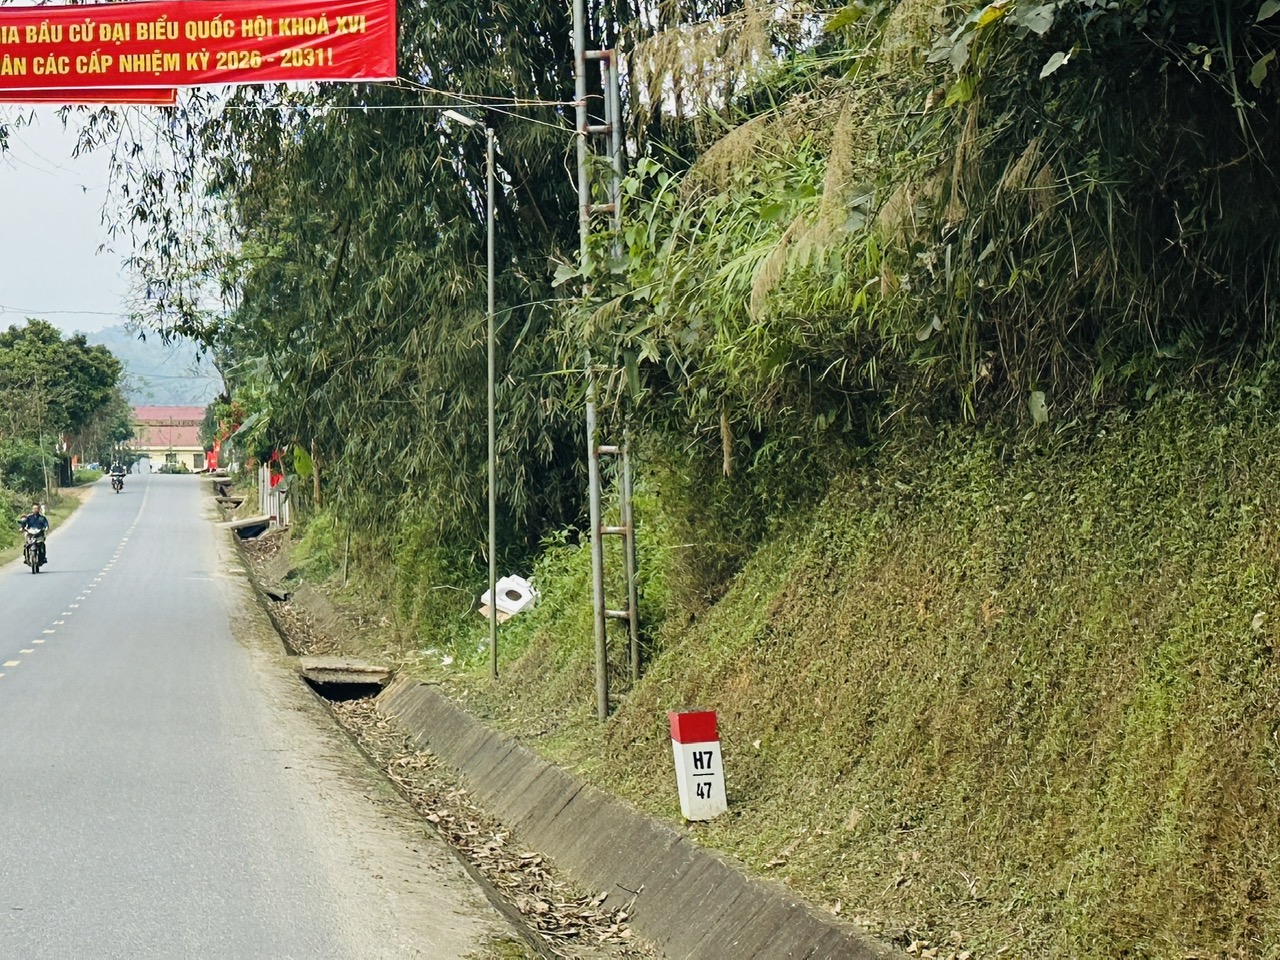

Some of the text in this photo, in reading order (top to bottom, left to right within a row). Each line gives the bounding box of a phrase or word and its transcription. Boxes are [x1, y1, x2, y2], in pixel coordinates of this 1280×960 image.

[25, 19, 62, 44] BẦU
[69, 18, 96, 42] CỬ
[99, 23, 130, 45] ĐẠI
[136, 14, 179, 40] BIỂU
[185, 13, 235, 41] QUỐC
[242, 15, 272, 41] HỘI
[336, 15, 366, 34] XVI
[33, 52, 70, 75] CÁC
[76, 48, 113, 74] CẤP
[119, 50, 180, 76] NHIỆM
[187, 48, 210, 71] KỲ
[216, 50, 262, 71] 2026
[280, 47, 334, 68] 2031!
[692, 751, 713, 770] H7
[696, 782, 712, 800] 47
